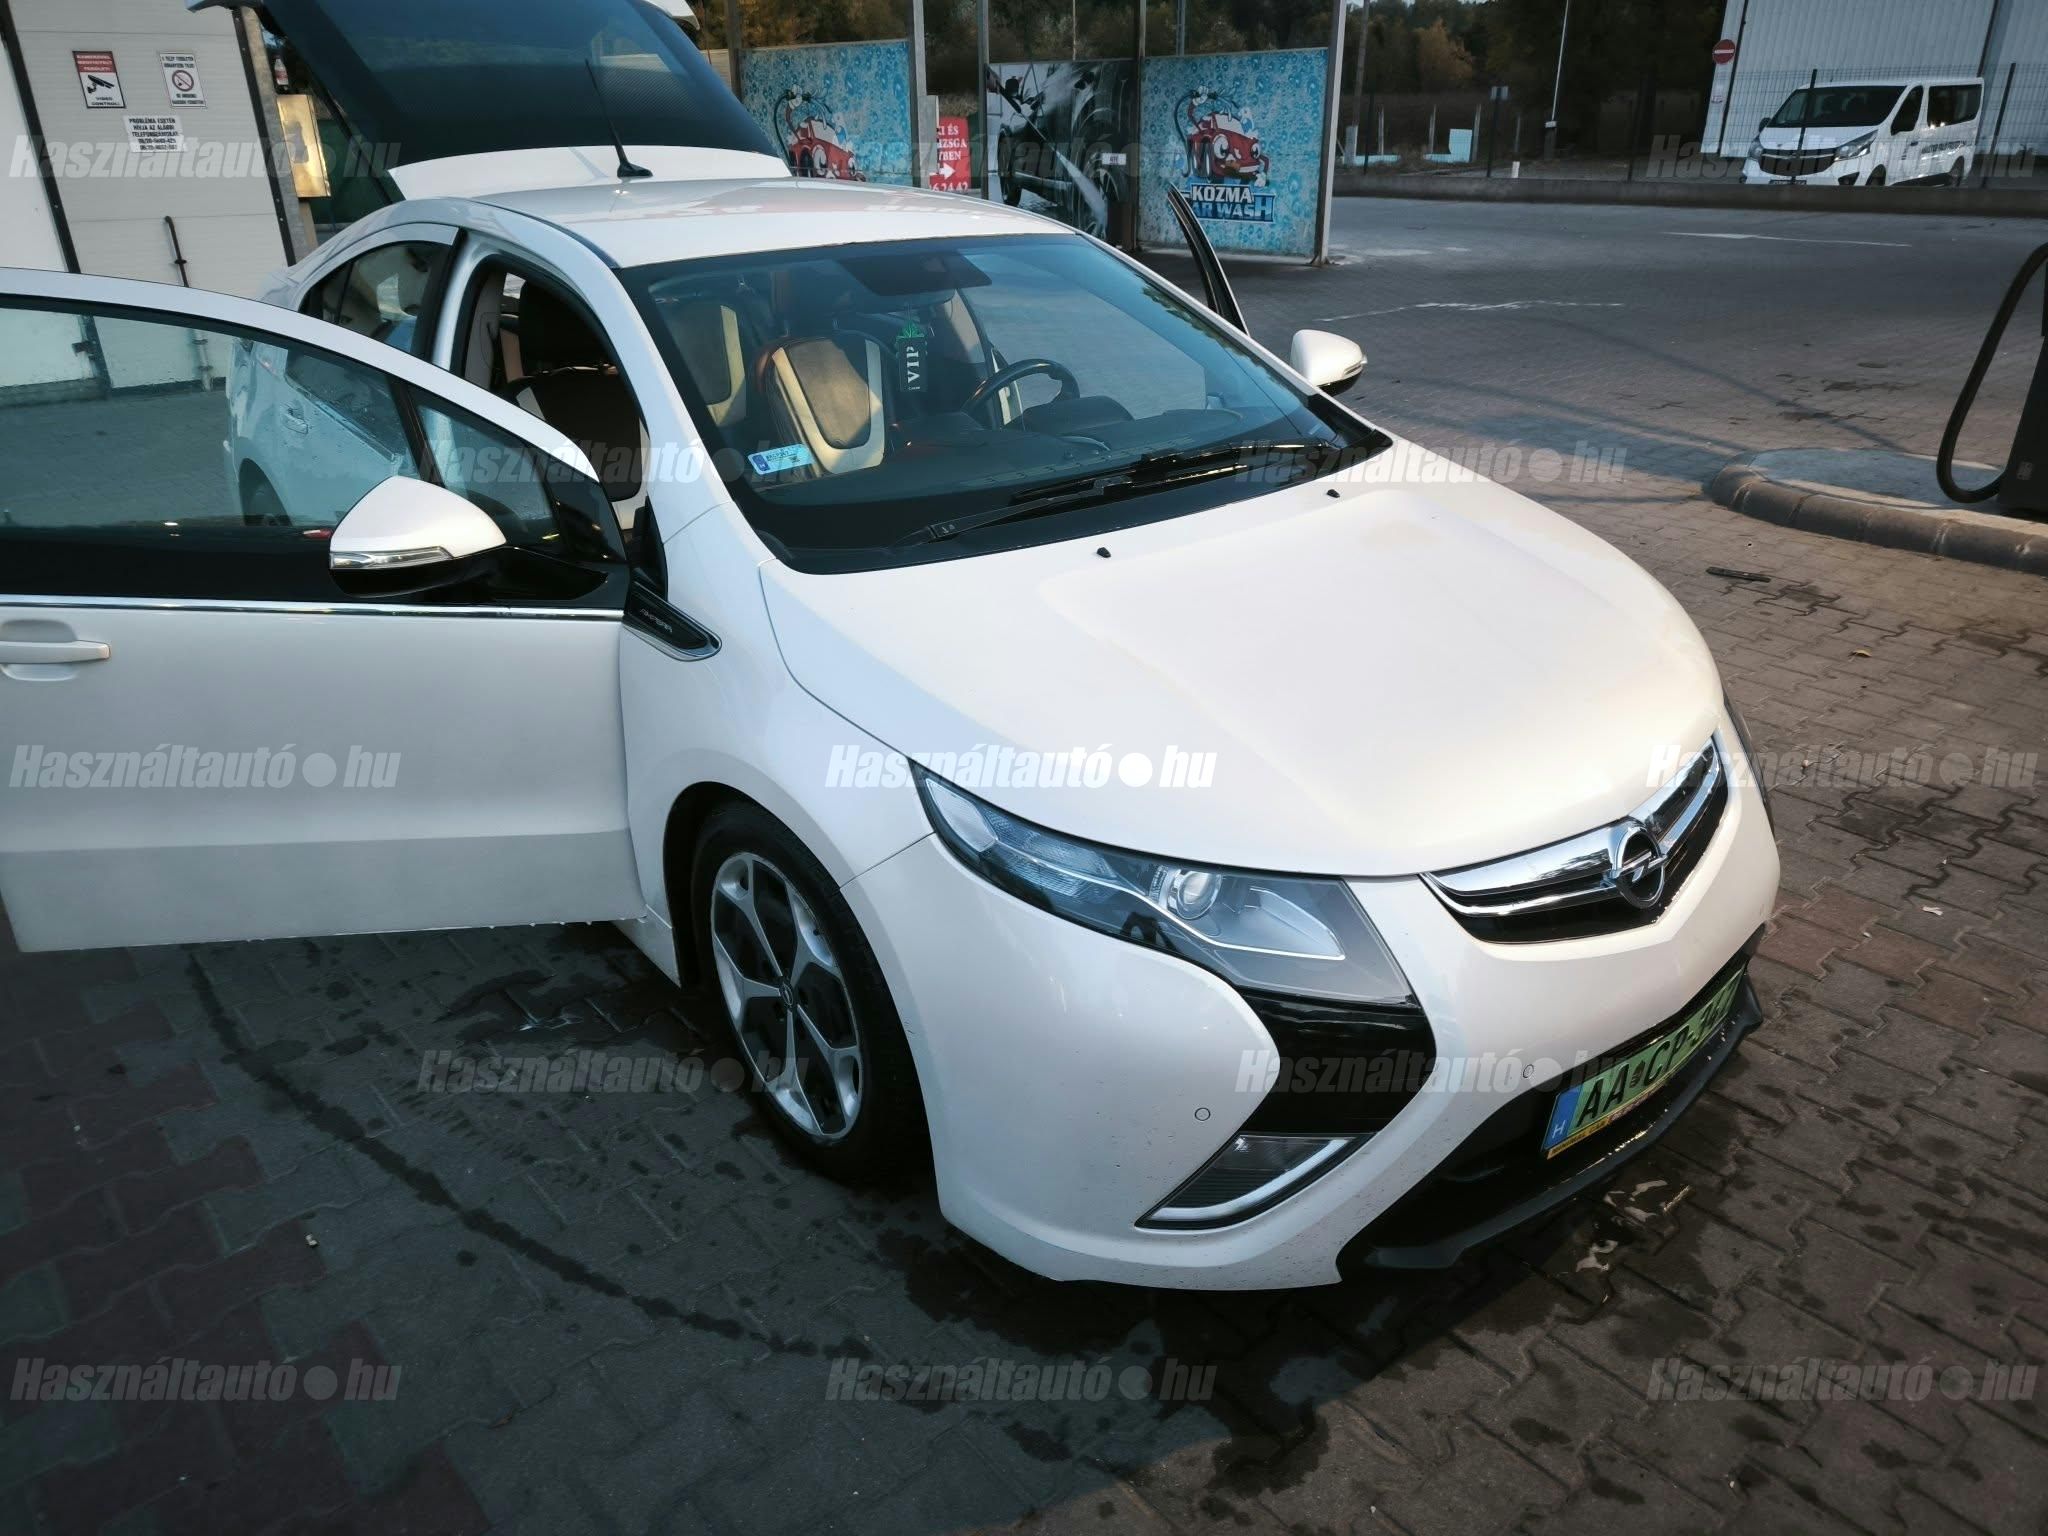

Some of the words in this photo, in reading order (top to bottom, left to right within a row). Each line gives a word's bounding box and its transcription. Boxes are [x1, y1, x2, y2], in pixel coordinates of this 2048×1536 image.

[1193, 186, 1253, 203] KOZMA
[1216, 195, 1273, 221] WASH
[906, 346, 920, 383] VIP
[1552, 1120, 1566, 1139] H
